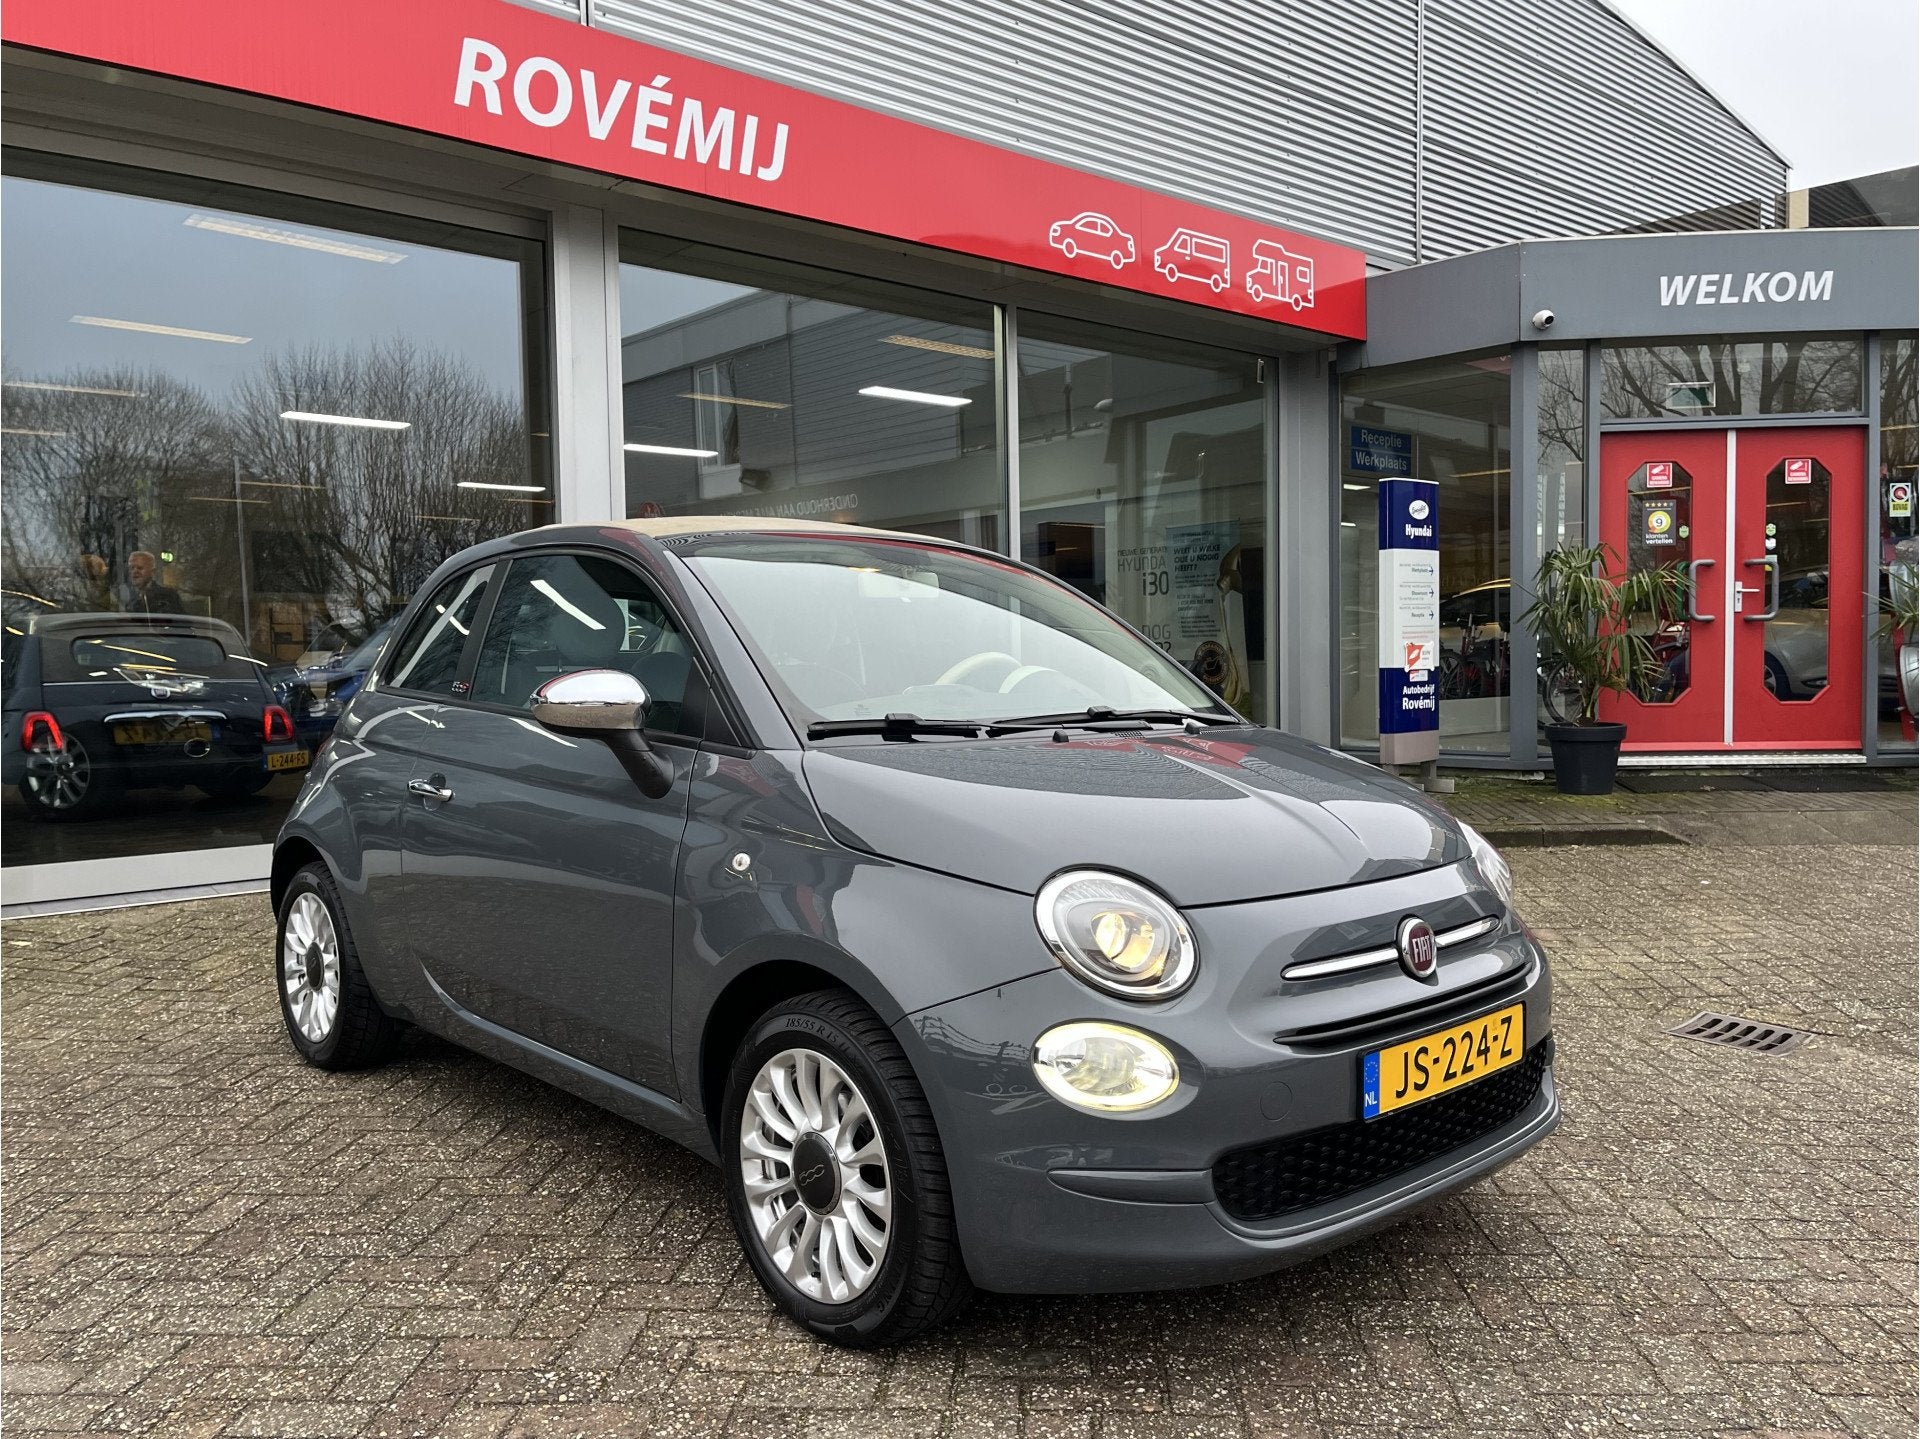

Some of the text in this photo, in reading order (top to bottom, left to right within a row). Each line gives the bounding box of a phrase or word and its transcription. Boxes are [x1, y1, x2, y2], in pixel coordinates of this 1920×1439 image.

[454, 37, 789, 181] ROVÉMIJ
[1660, 270, 1834, 306] WELKOM
[1361, 429, 1402, 449] Receptie
[1355, 450, 1407, 470] Werkplaats
[1405, 523, 1433, 539] Hyundai
[1117, 556, 1167, 573] HYUNDA
[1142, 571, 1169, 596] i30
[1402, 684, 1435, 695] Autobedrijf
[1402, 696, 1435, 711] Rovémij
[1411, 935, 1430, 964] FIAT
[785, 1017, 839, 1042] 185/55 R 15
[1395, 1015, 1513, 1099] JS-224-Z
[1364, 1092, 1377, 1107] NL
